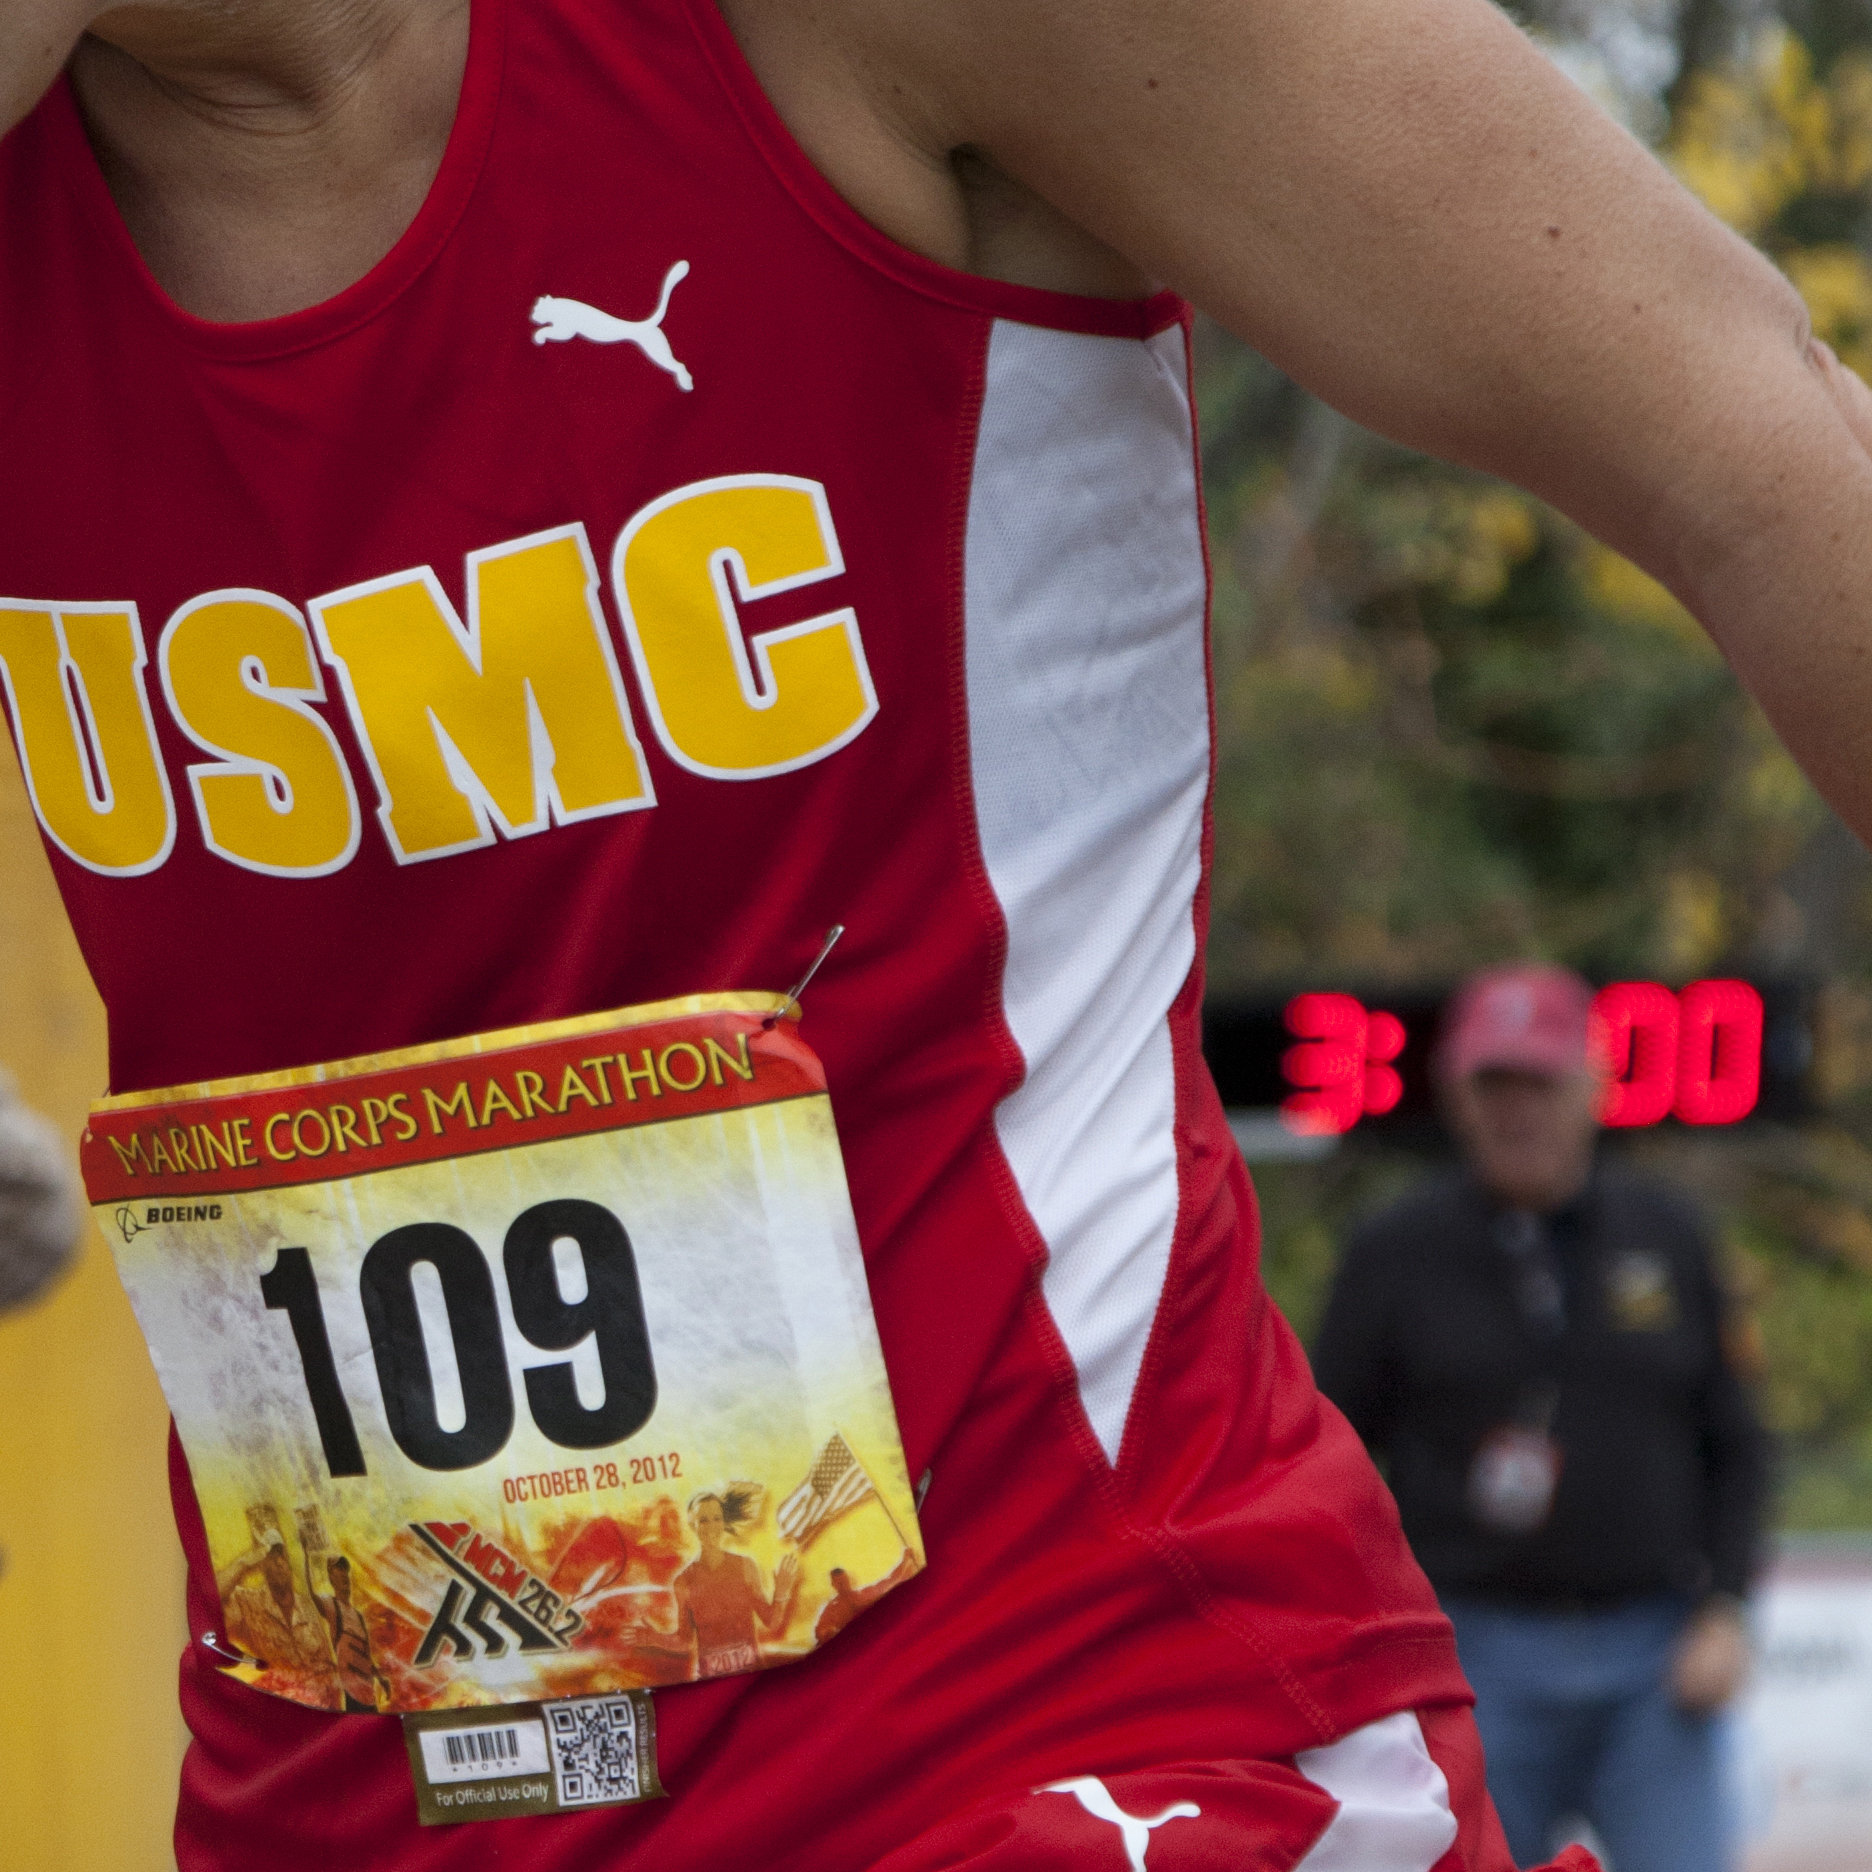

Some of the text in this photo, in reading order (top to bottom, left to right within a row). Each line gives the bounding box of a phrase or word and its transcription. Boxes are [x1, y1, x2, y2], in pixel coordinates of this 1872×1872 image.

[107, 1031, 755, 1176] MARINE CORPS MARATHON
[146, 1204, 223, 1225] BOEING
[259, 1197, 660, 1480] 109
[502, 1451, 684, 1504] OCTOBER 28, 2012
[463, 1533, 583, 1647] MCM 26.2
[638, 1703, 649, 1746] RESULTS
[436, 1782, 549, 1807] For Official Use Only
